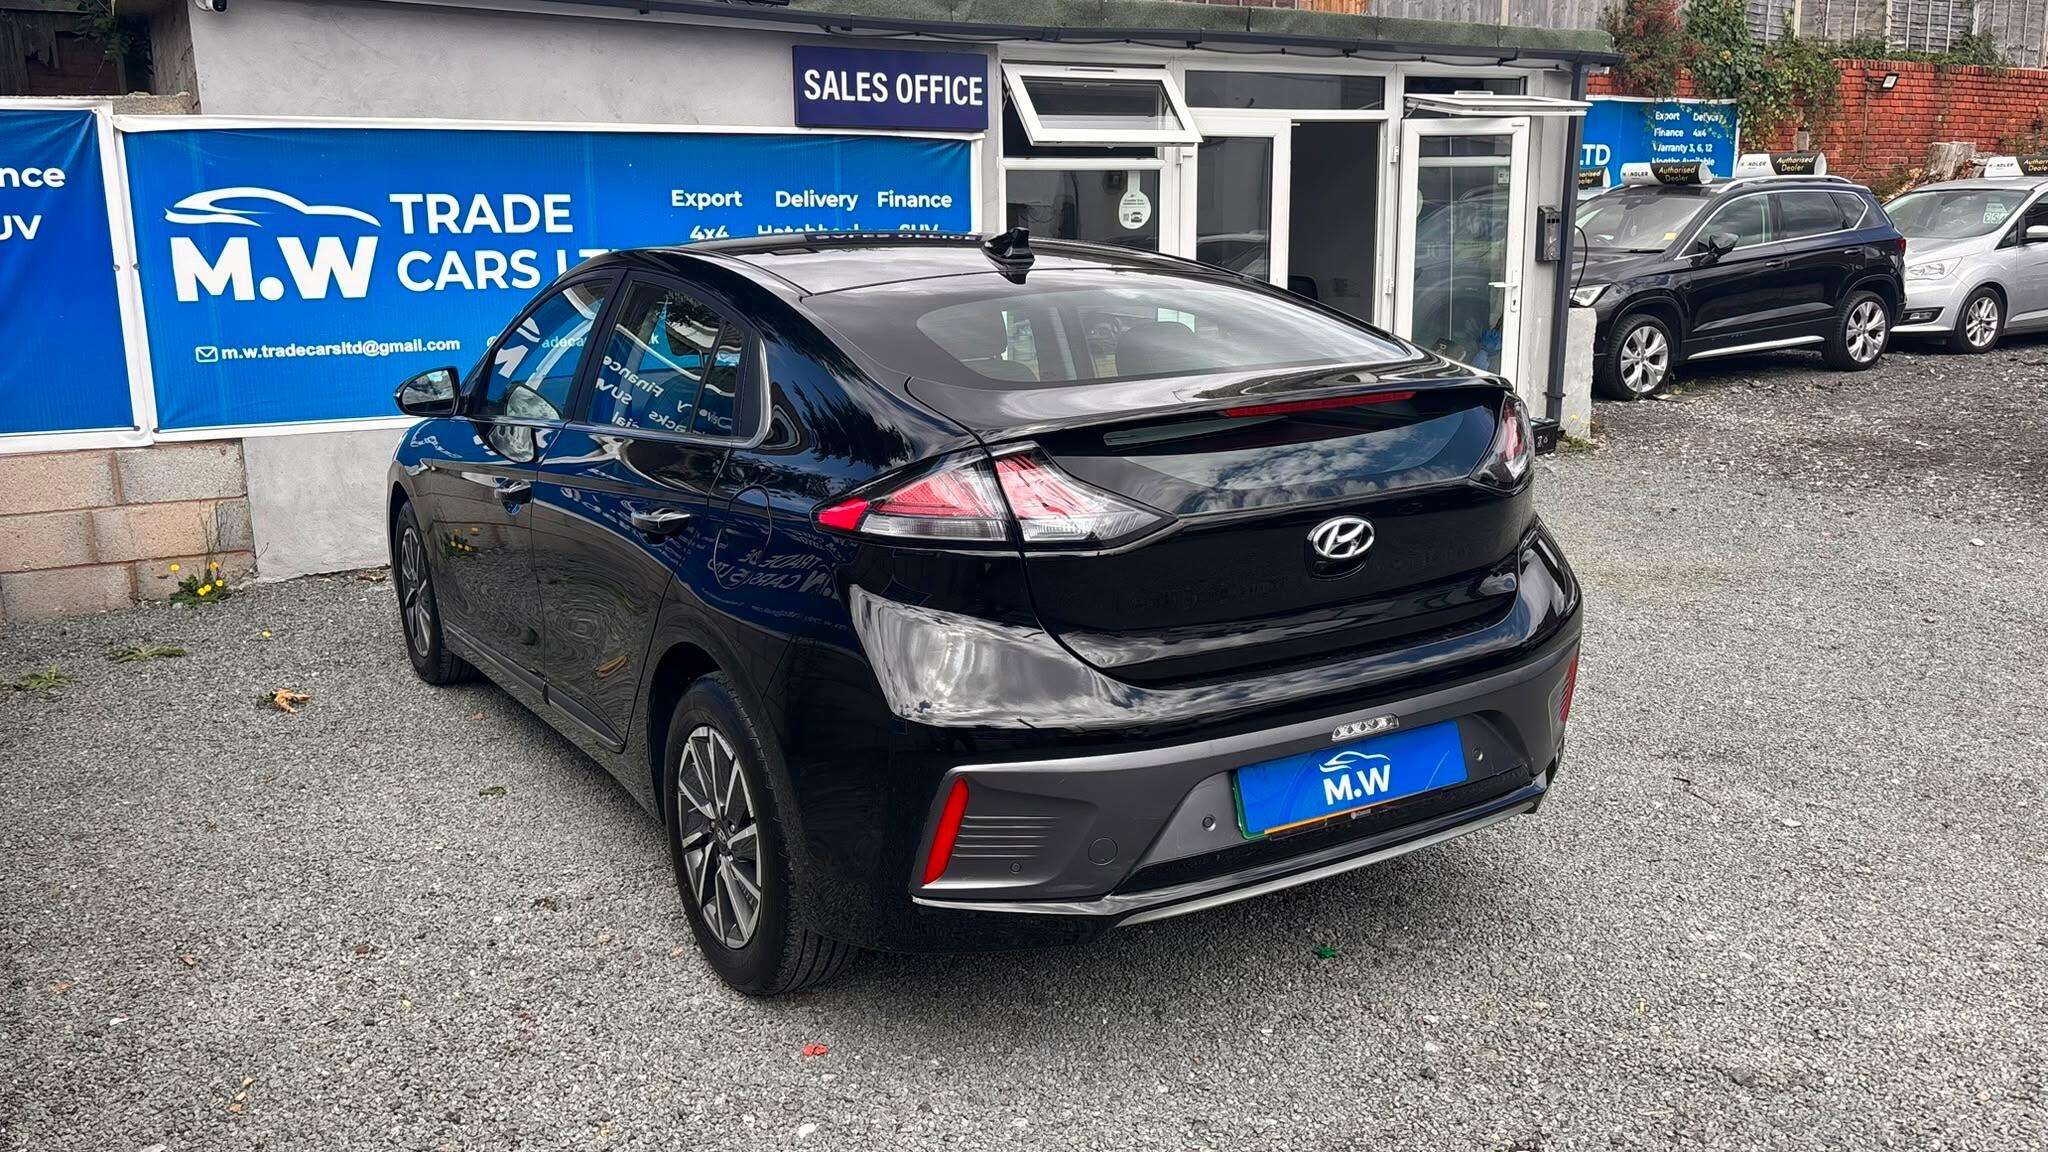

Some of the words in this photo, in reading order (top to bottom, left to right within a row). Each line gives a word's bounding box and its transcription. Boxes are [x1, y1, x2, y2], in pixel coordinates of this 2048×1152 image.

[803, 69, 887, 102] SALES
[896, 73, 983, 106] OFFICE
[1655, 111, 1680, 122] Export
[1580, 143, 1611, 166] TD
[1658, 165, 1696, 174] Authorised
[389, 193, 573, 234] TRADE
[671, 190, 743, 210] Export
[775, 190, 859, 211] Delivery
[877, 191, 953, 208] Finance
[169, 236, 378, 302] M.W
[397, 249, 541, 292] CARS
[221, 338, 461, 360] m.w.tradecarsltd@gmail.com
[1323, 764, 1391, 806] M.W
